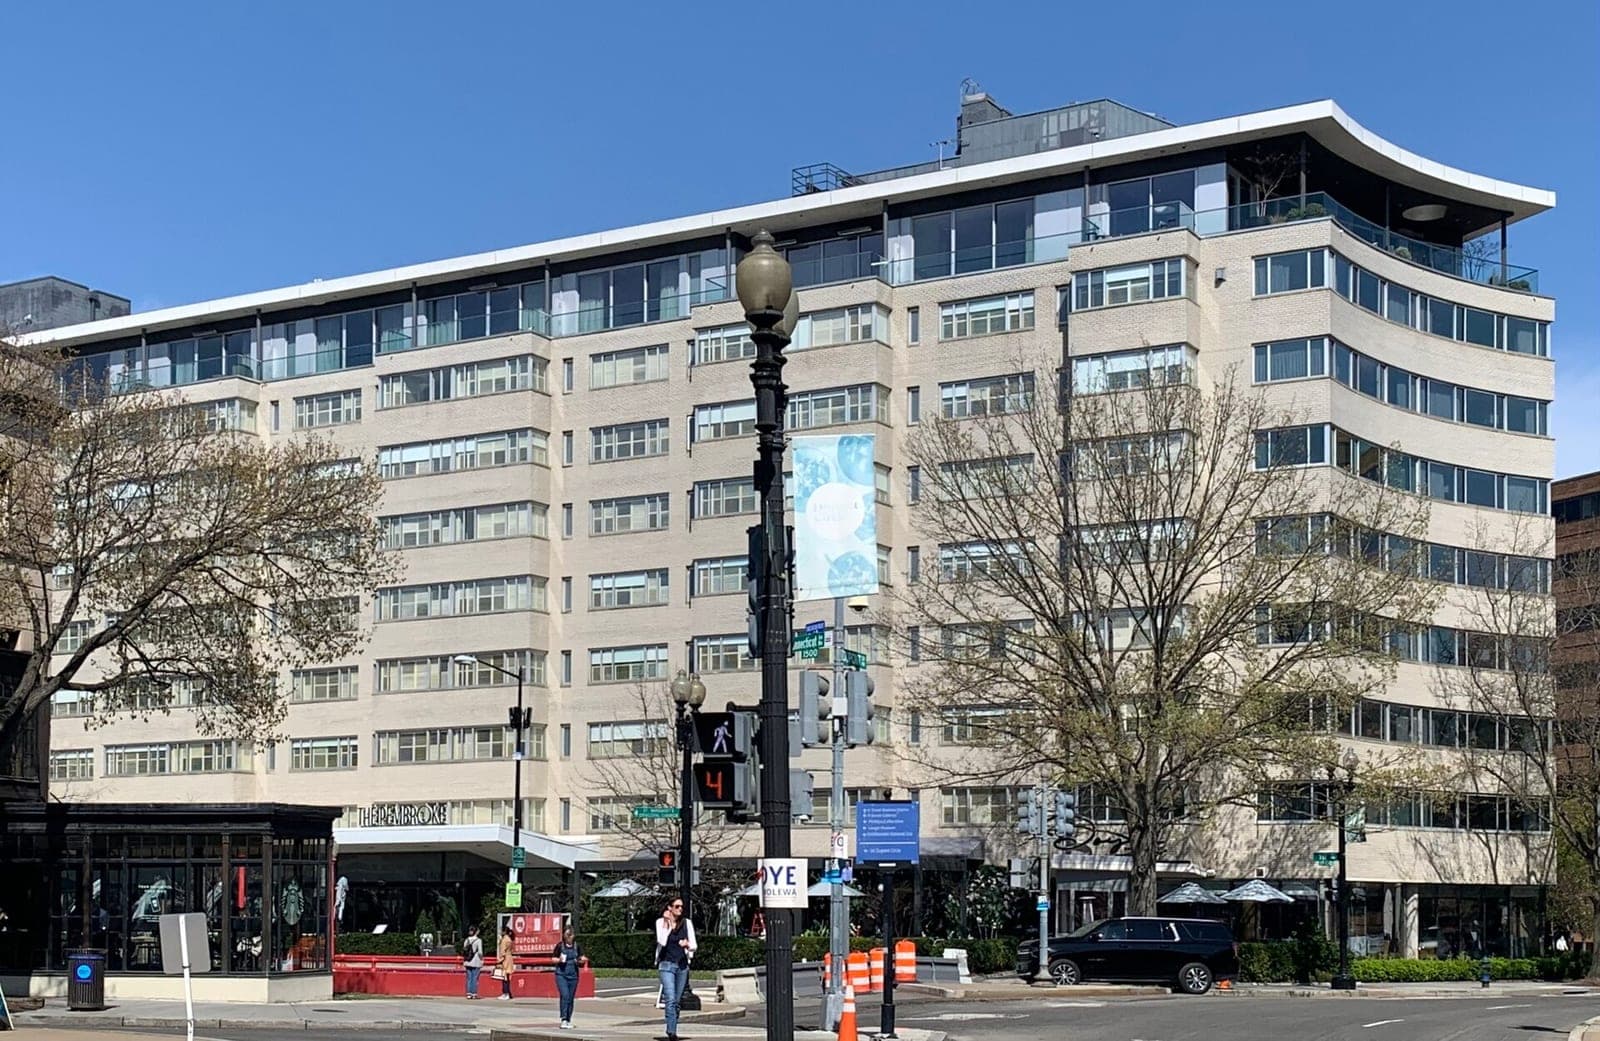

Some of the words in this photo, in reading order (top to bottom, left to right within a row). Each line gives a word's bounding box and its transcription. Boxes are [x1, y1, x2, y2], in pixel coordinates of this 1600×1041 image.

[803, 649, 818, 658] 1500
[706, 771, 722, 799] 4
[358, 803, 379, 827] THE
[379, 803, 447, 826] PEMBROKE
[764, 888, 797, 896] OLEWA
